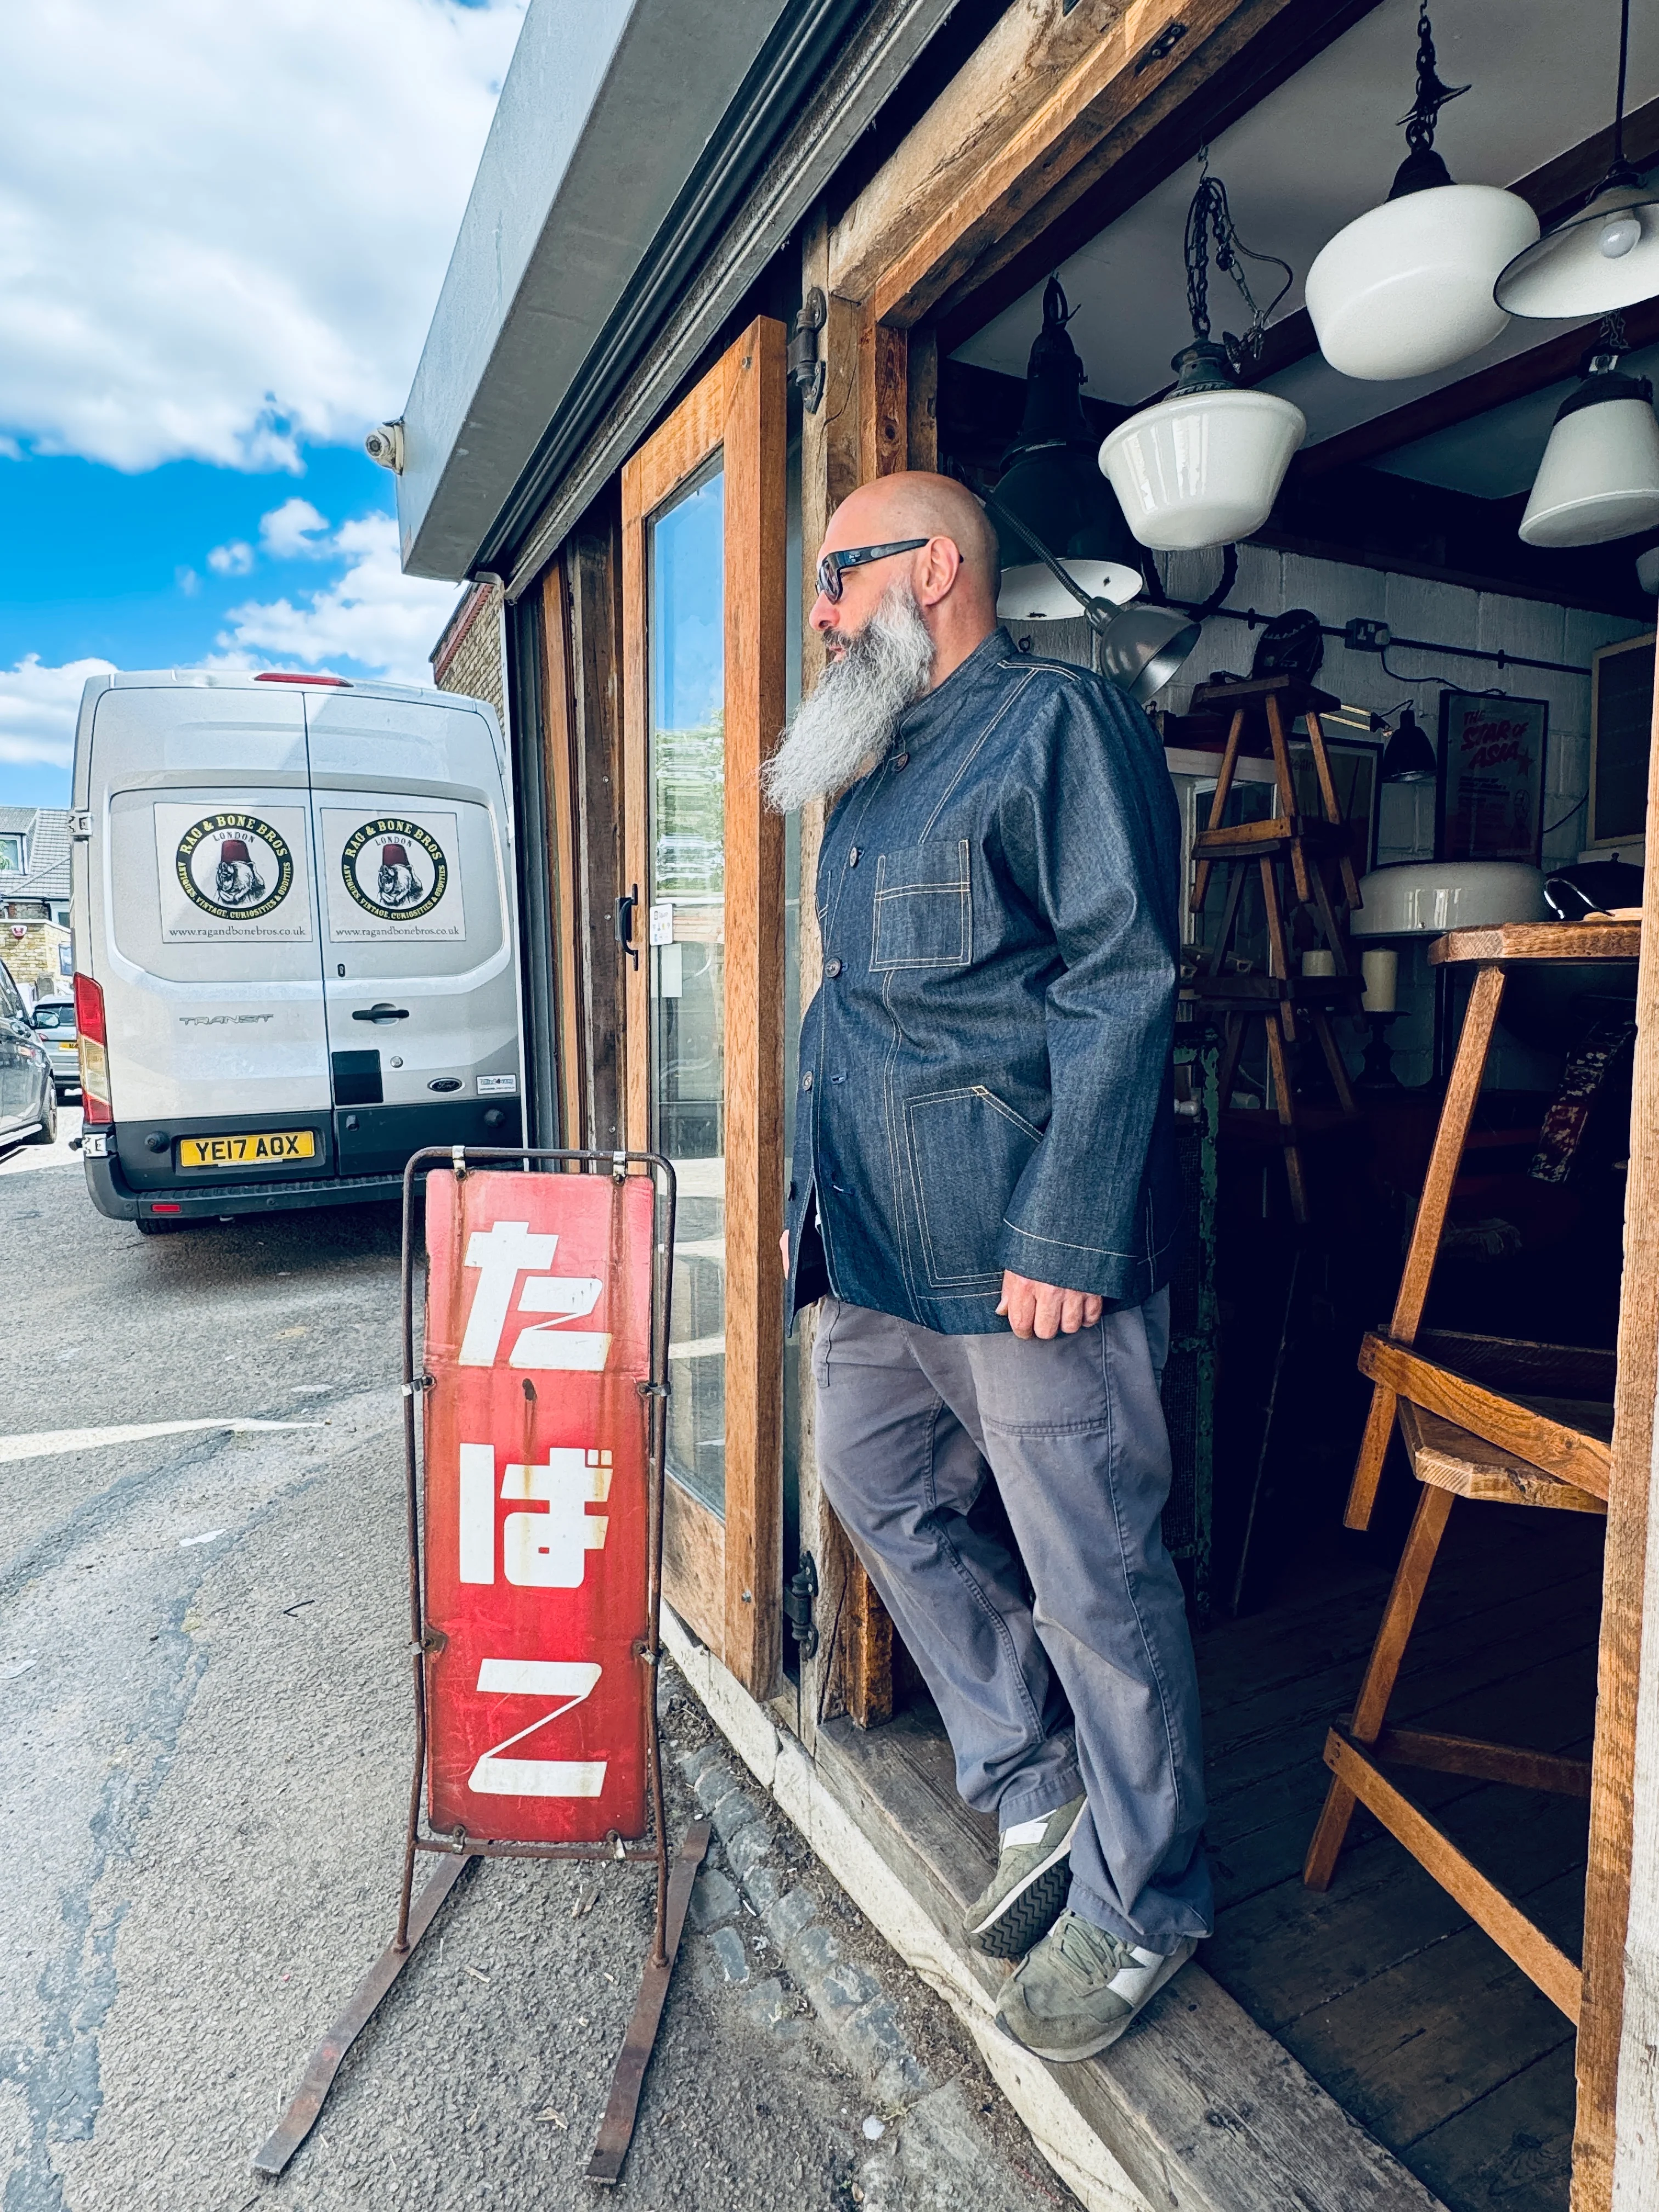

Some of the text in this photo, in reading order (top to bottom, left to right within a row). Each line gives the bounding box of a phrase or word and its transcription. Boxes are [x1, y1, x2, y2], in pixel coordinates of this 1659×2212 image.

[1464, 710, 1485, 725] THE
[1461, 720, 1529, 751] STAR OF
[1469, 741, 1519, 769] ASIA
[180, 815, 288, 857] RAG & BONE BROS
[212, 832, 256, 843] LONDON
[345, 821, 442, 860] RAG & BONE BROS
[374, 836, 413, 847] LONDON
[168, 926, 306, 938] www.ragandbonebros.co.uk
[336, 926, 460, 938] www.ragandbonebros.co.uk
[179, 1014, 274, 1025] TRANSIT
[195, 1139, 247, 1161] YE17
[459, 1221, 613, 1798] たばこ
